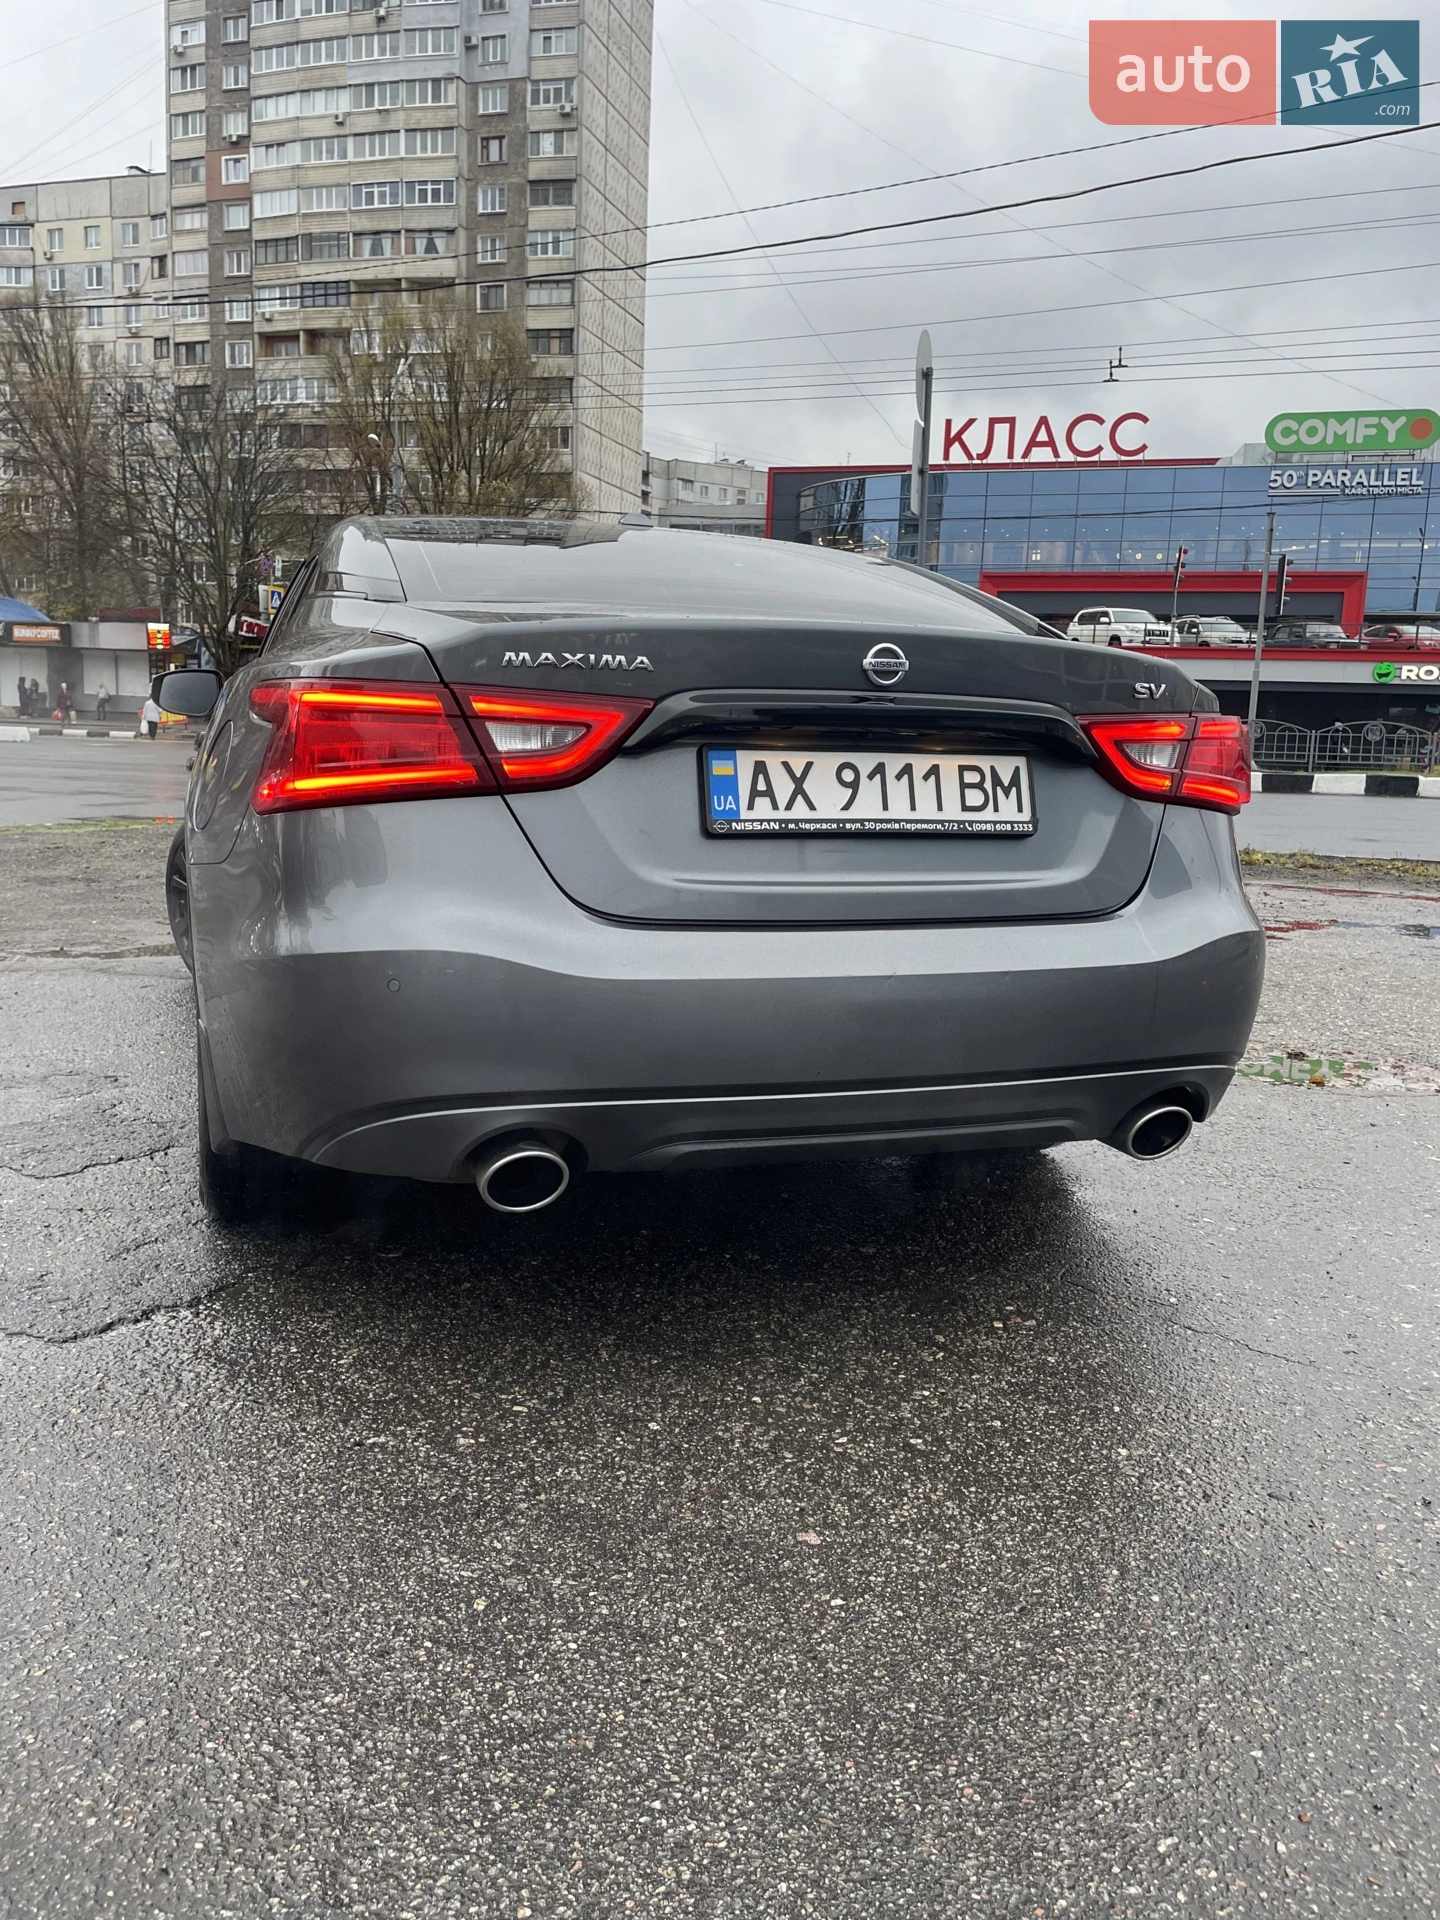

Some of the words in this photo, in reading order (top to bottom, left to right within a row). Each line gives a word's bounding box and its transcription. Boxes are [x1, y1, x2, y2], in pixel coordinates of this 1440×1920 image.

[943, 412, 1150, 461] КЛАСС
[1273, 416, 1407, 446] COMFY
[1307, 468, 1424, 487] PARALLEL
[1345, 487, 1368, 495] КАФЕ
[1397, 486, 1423, 494] МІСТА
[501, 651, 655, 672] MAXIMA
[868, 661, 905, 669] NISSAN
[1401, 665, 1440, 681] RO
[1133, 682, 1166, 699] SV
[747, 760, 817, 811] AX
[835, 762, 943, 812] 9111
[958, 764, 1024, 813] BM
[714, 795, 737, 811] UA
[732, 822, 779, 830] NISSAN
[973, 823, 994, 832] (098)
[995, 823, 1011, 831] 608
[1013, 824, 1033, 832] 3333
